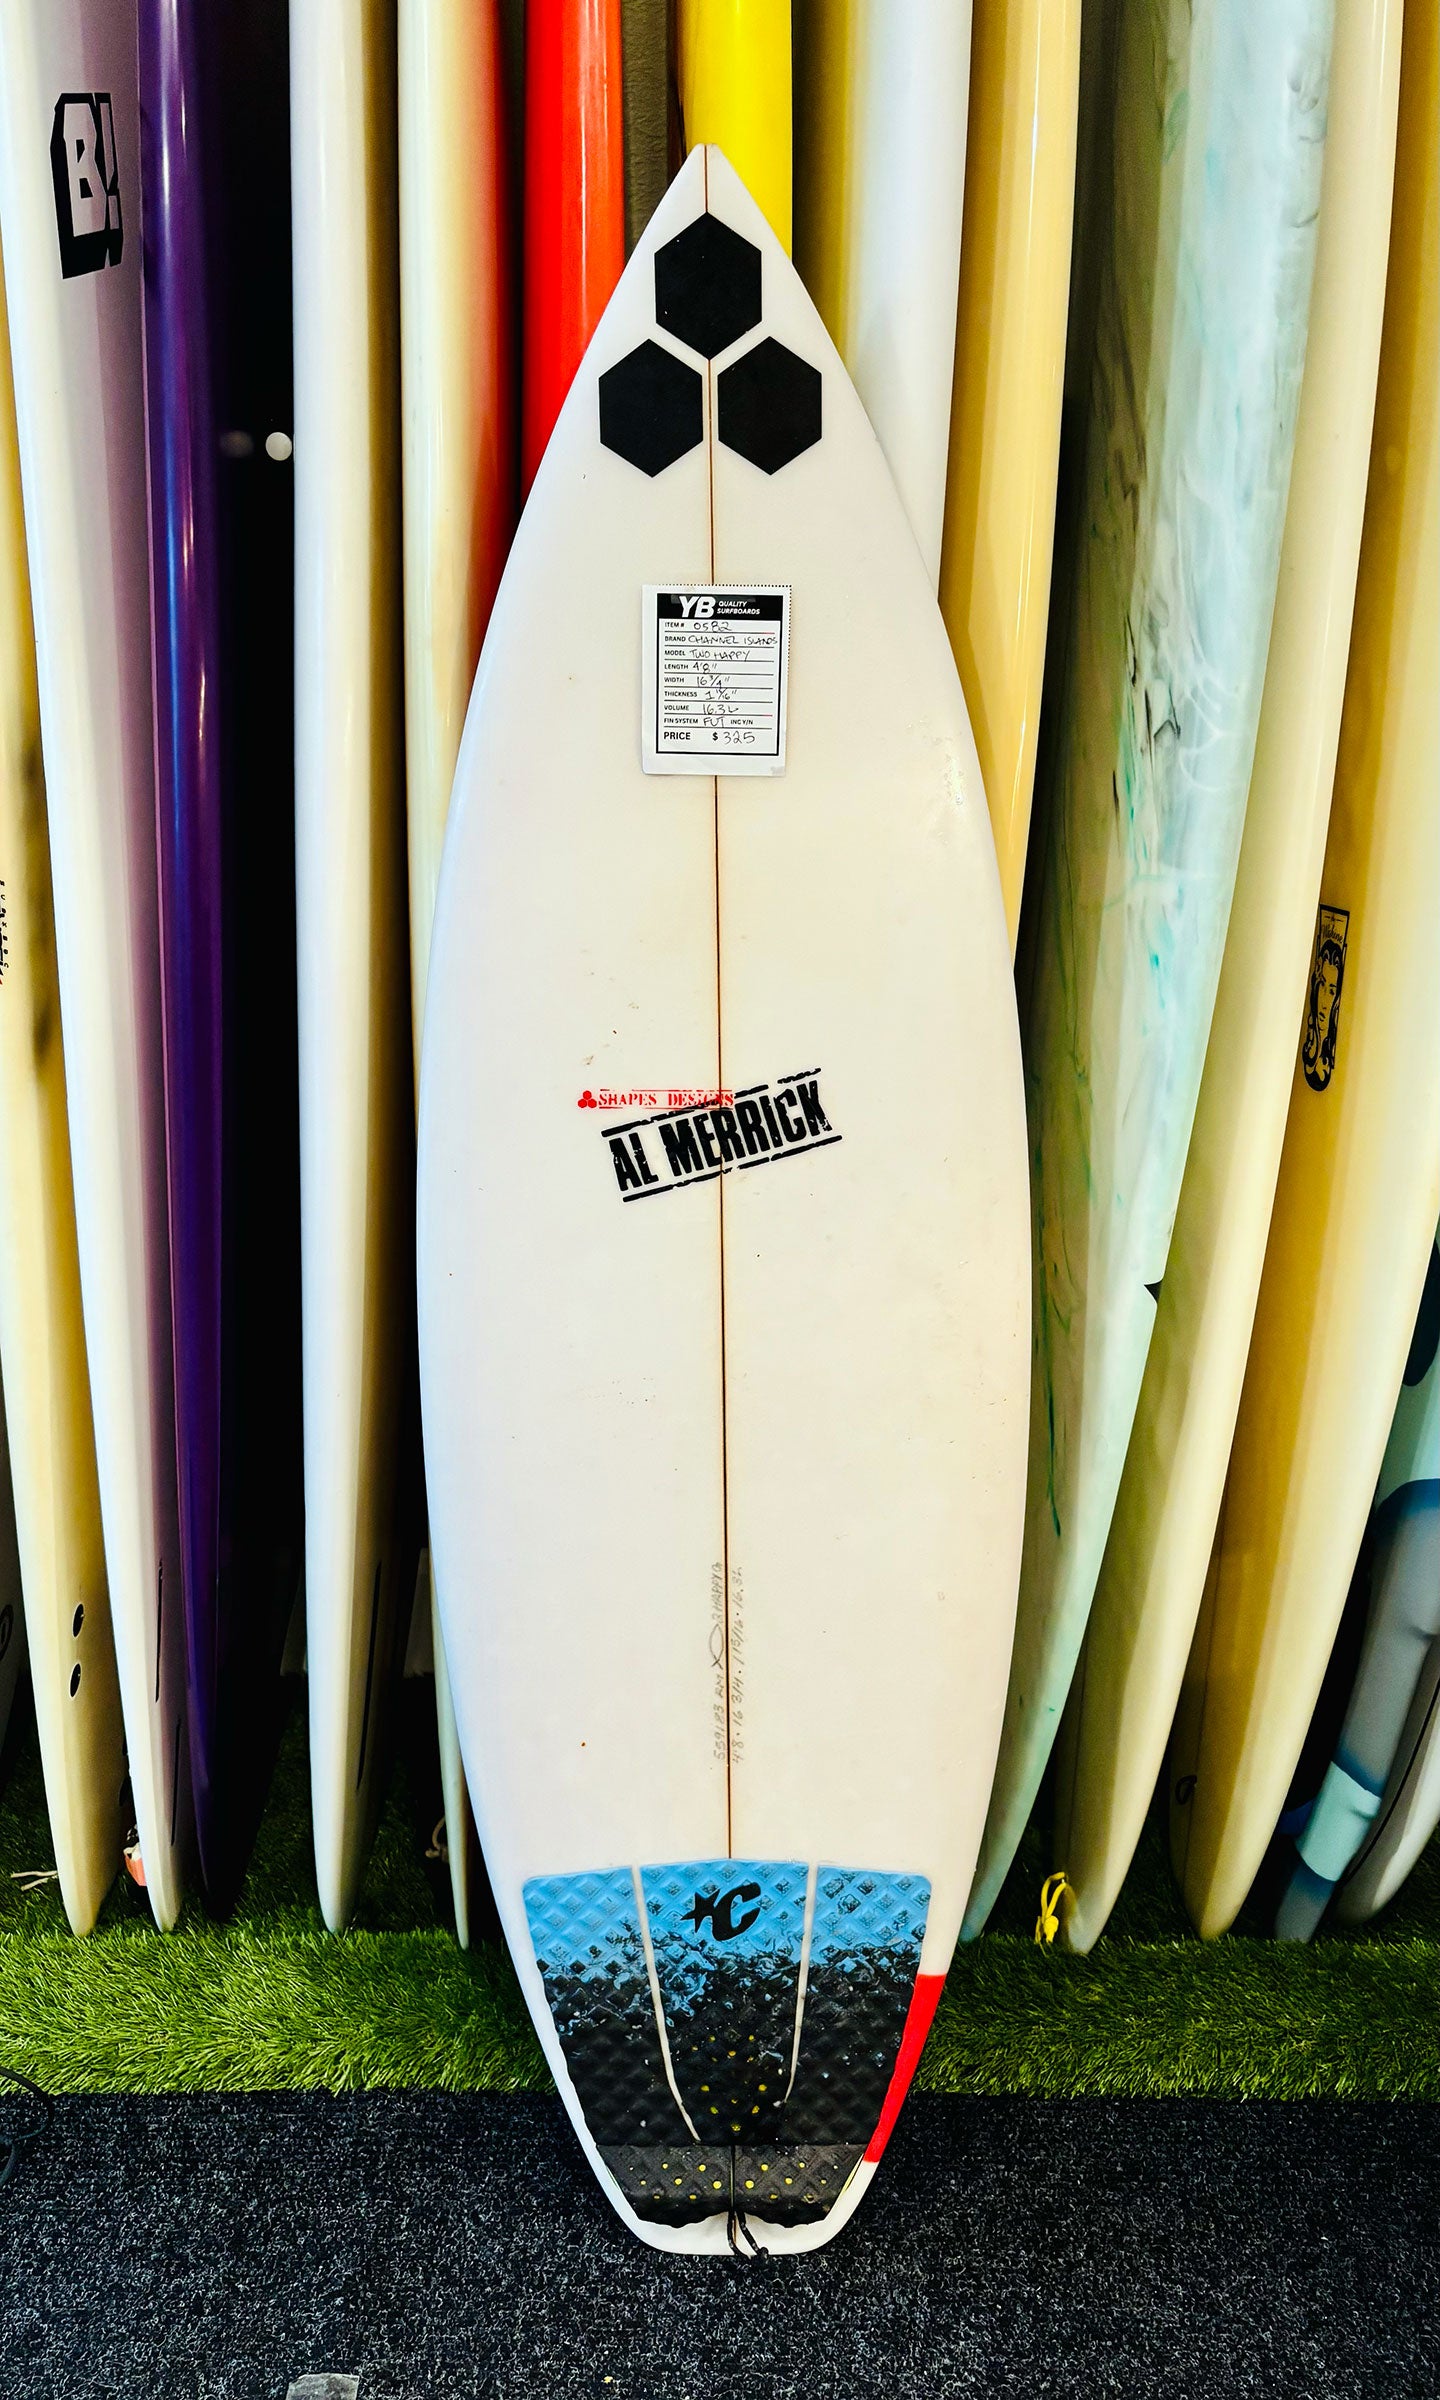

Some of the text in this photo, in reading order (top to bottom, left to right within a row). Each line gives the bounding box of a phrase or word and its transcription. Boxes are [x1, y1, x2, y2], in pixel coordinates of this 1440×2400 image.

[679, 596, 716, 618] YB
[693, 621, 732, 633] 0582
[688, 635, 739, 645] CHANNEL
[744, 636, 778, 646] ISLANDS
[690, 649, 711, 659] TWO
[713, 650, 750, 662] HAPPY
[703, 715, 725, 728] FUT
[663, 730, 756, 745] PRICE $ 325
[599, 1092, 734, 1107] SHAPES DESIGNS
[609, 1080, 833, 1192] AL MERRICK
